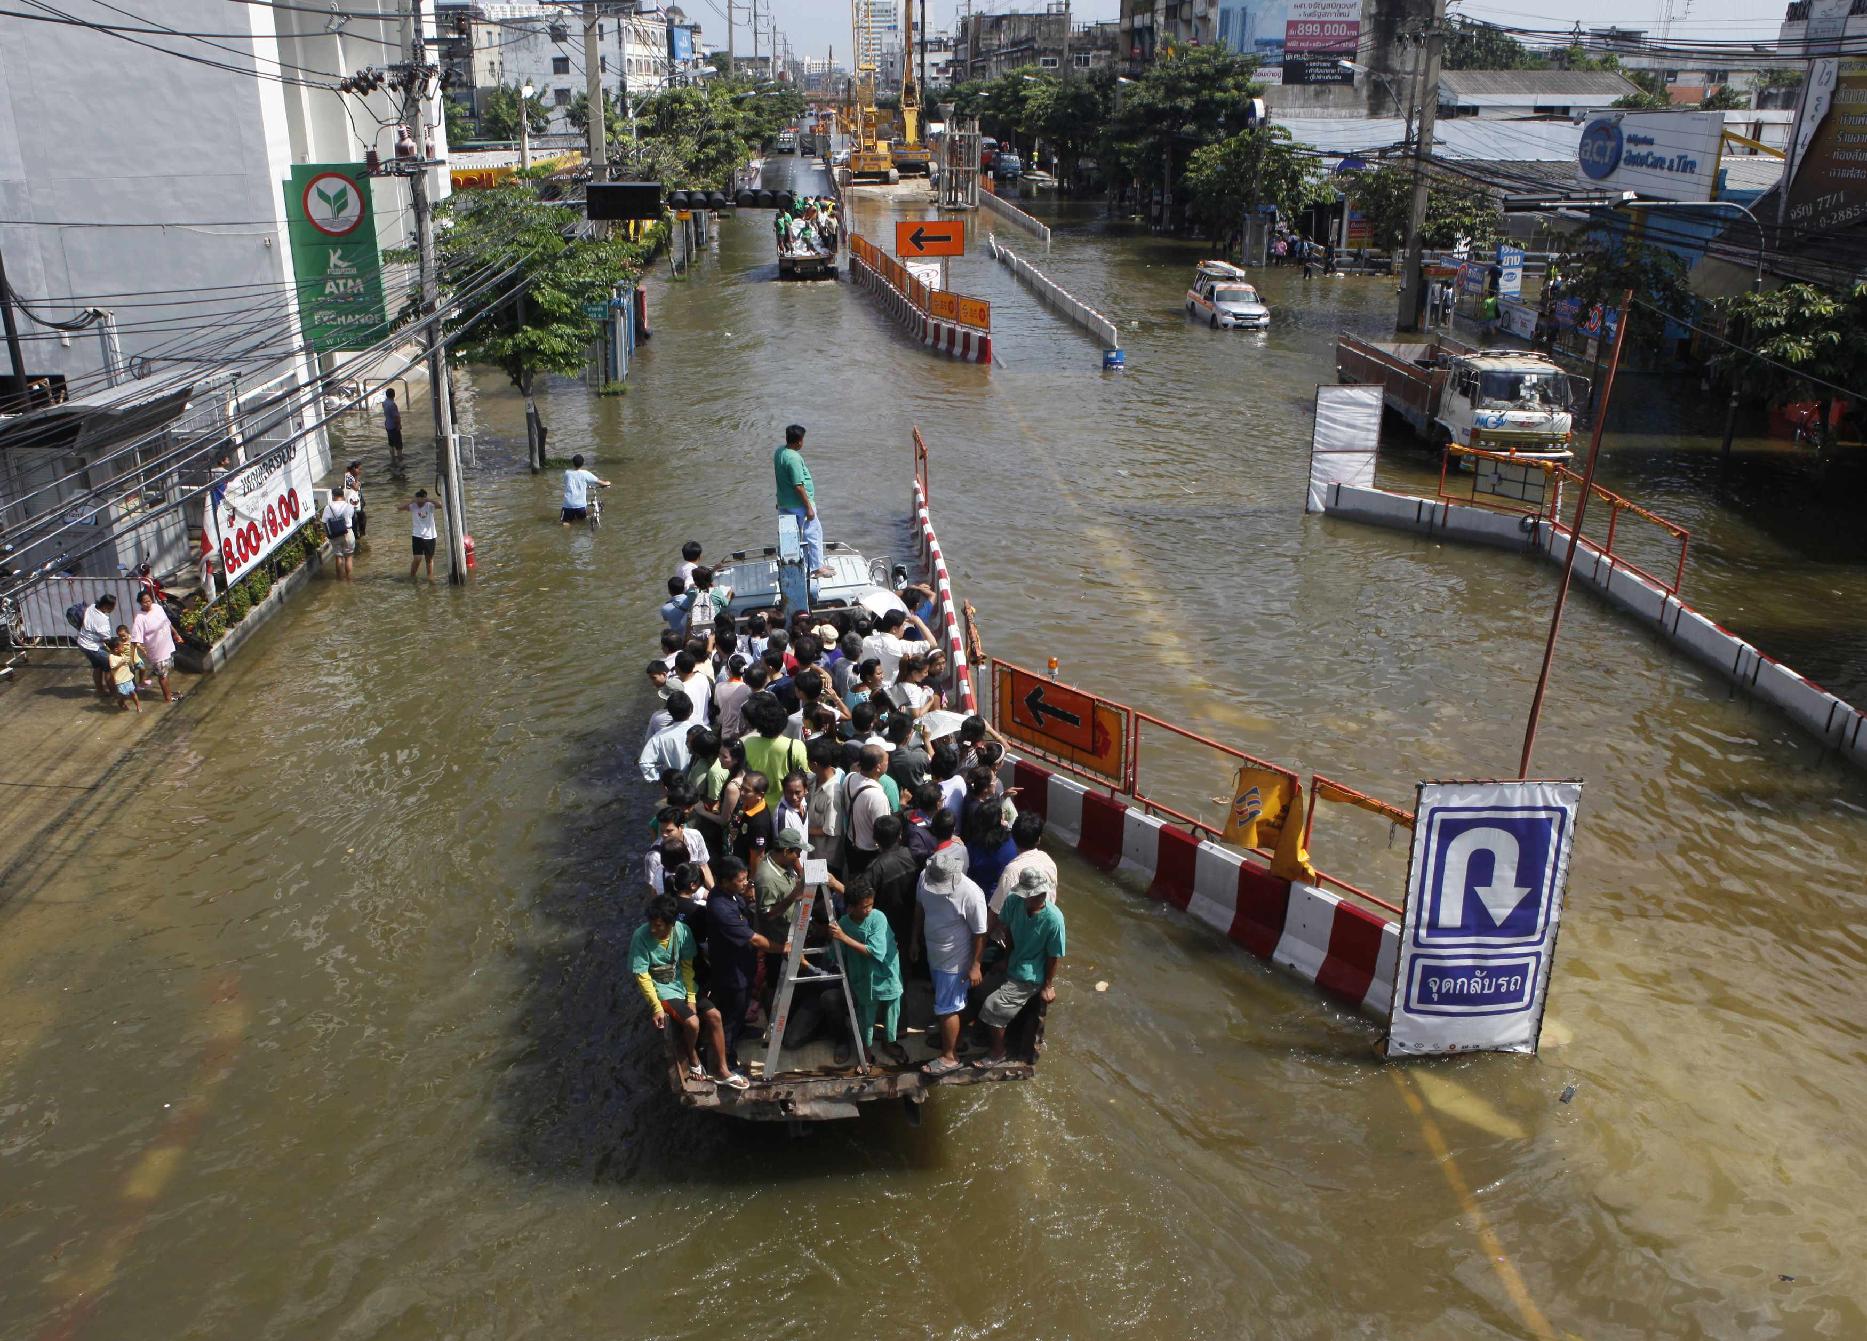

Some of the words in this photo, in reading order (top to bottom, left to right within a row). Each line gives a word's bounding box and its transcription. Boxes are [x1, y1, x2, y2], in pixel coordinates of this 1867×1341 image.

[1297, 23, 1346, 37] 899,000
[324, 278, 365, 295] ATM
[222, 487, 300, 574] 8.00-19.00
[1427, 970, 1522, 1002] จุดกลับรถ
